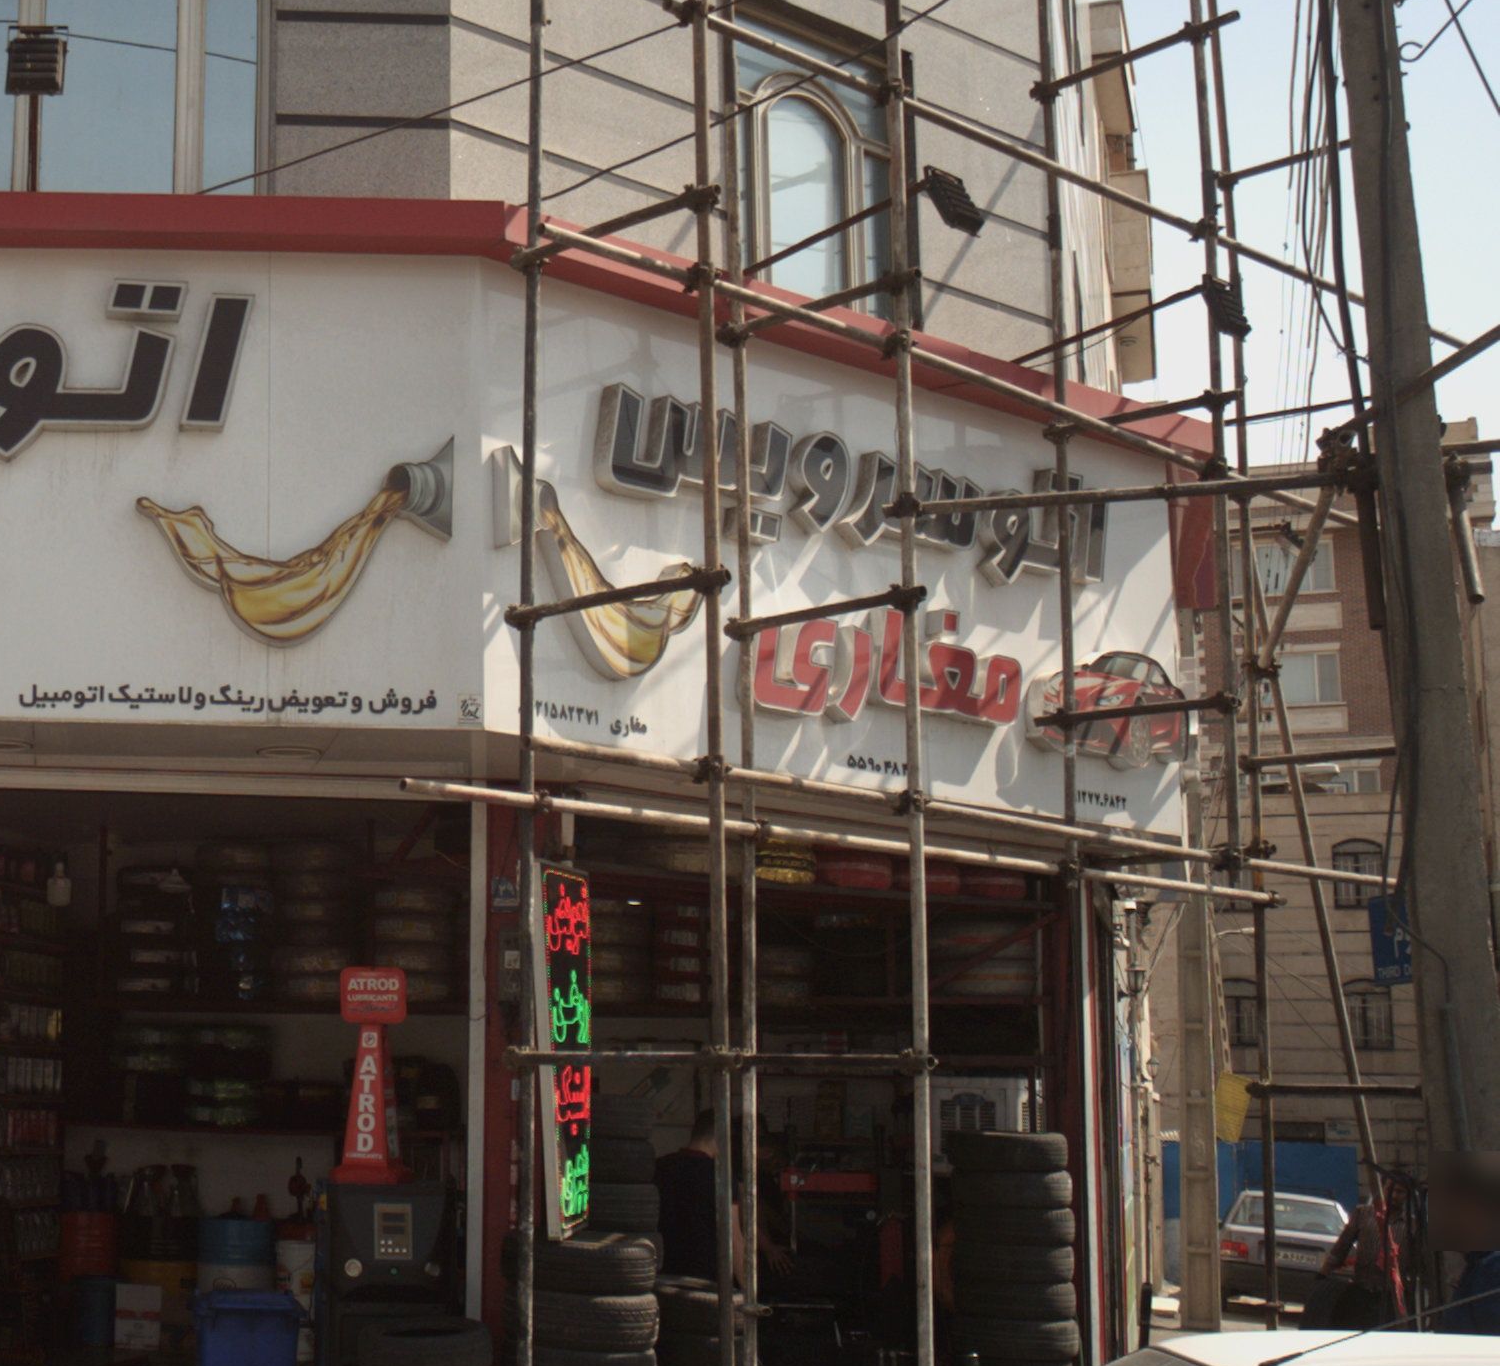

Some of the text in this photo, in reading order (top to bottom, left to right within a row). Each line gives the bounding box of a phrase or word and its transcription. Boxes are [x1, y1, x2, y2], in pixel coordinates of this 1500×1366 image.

[740, 606, 1023, 727] مغاری
[18, 684, 105, 709] اتومبیل
[107, 685, 193, 710] لاستیک
[209, 685, 266, 714] رینگ
[267, 690, 349, 714] تعویض
[368, 688, 438, 714] فروش
[609, 715, 648, 737] مغاری
[347, 977, 400, 991] ATROD
[356, 1054, 377, 1153] ATROD
